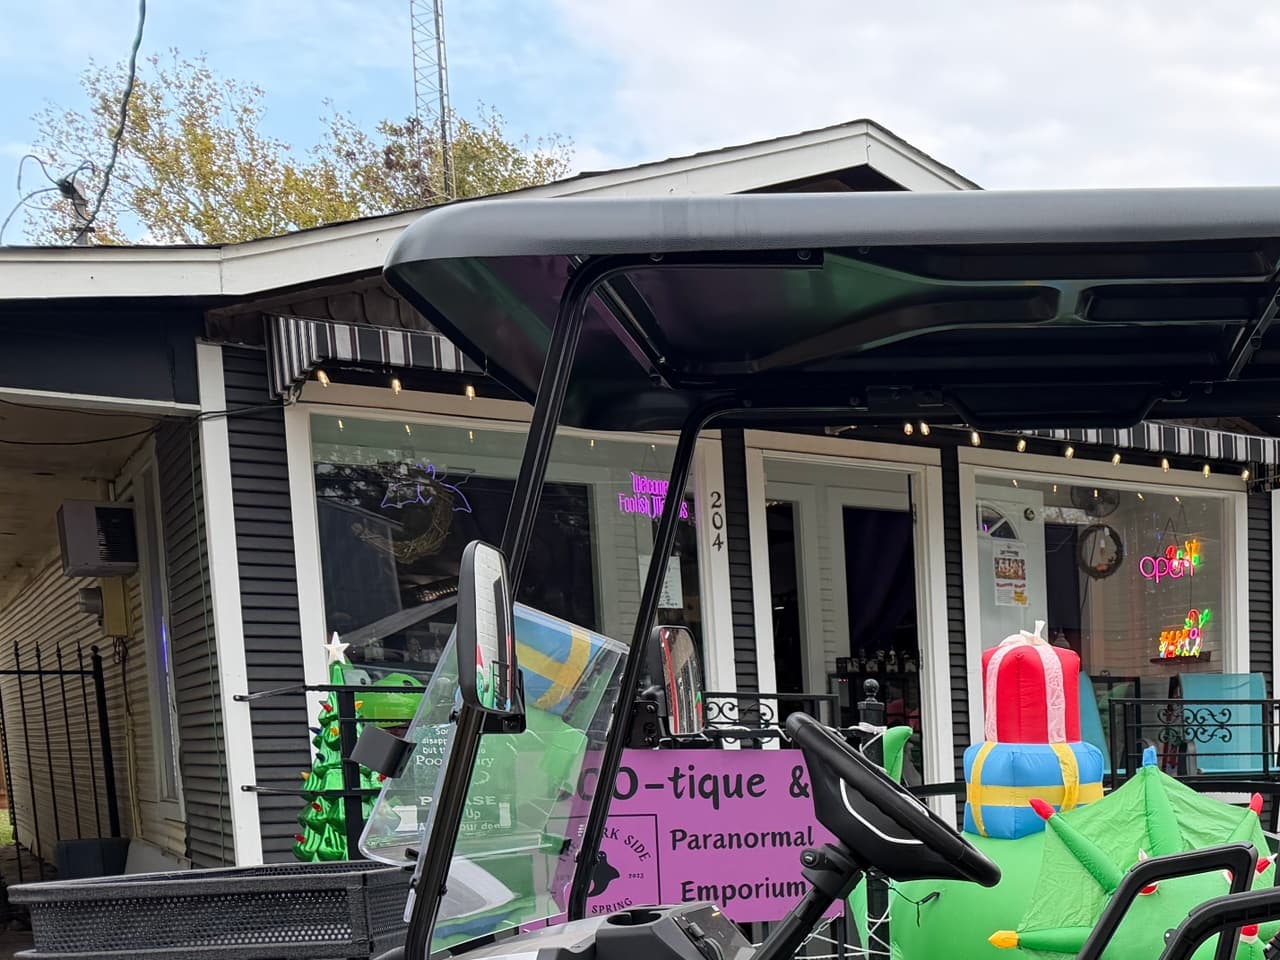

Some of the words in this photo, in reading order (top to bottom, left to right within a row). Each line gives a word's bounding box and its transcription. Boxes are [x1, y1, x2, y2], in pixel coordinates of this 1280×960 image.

[709, 490, 725, 552] 204
[415, 754, 443, 766] Poo
[788, 764, 810, 799] &
[624, 834, 652, 862] SIDE
[669, 825, 815, 851] Paranormal
[591, 897, 633, 914] SPRING
[680, 877, 808, 909] Emporium
